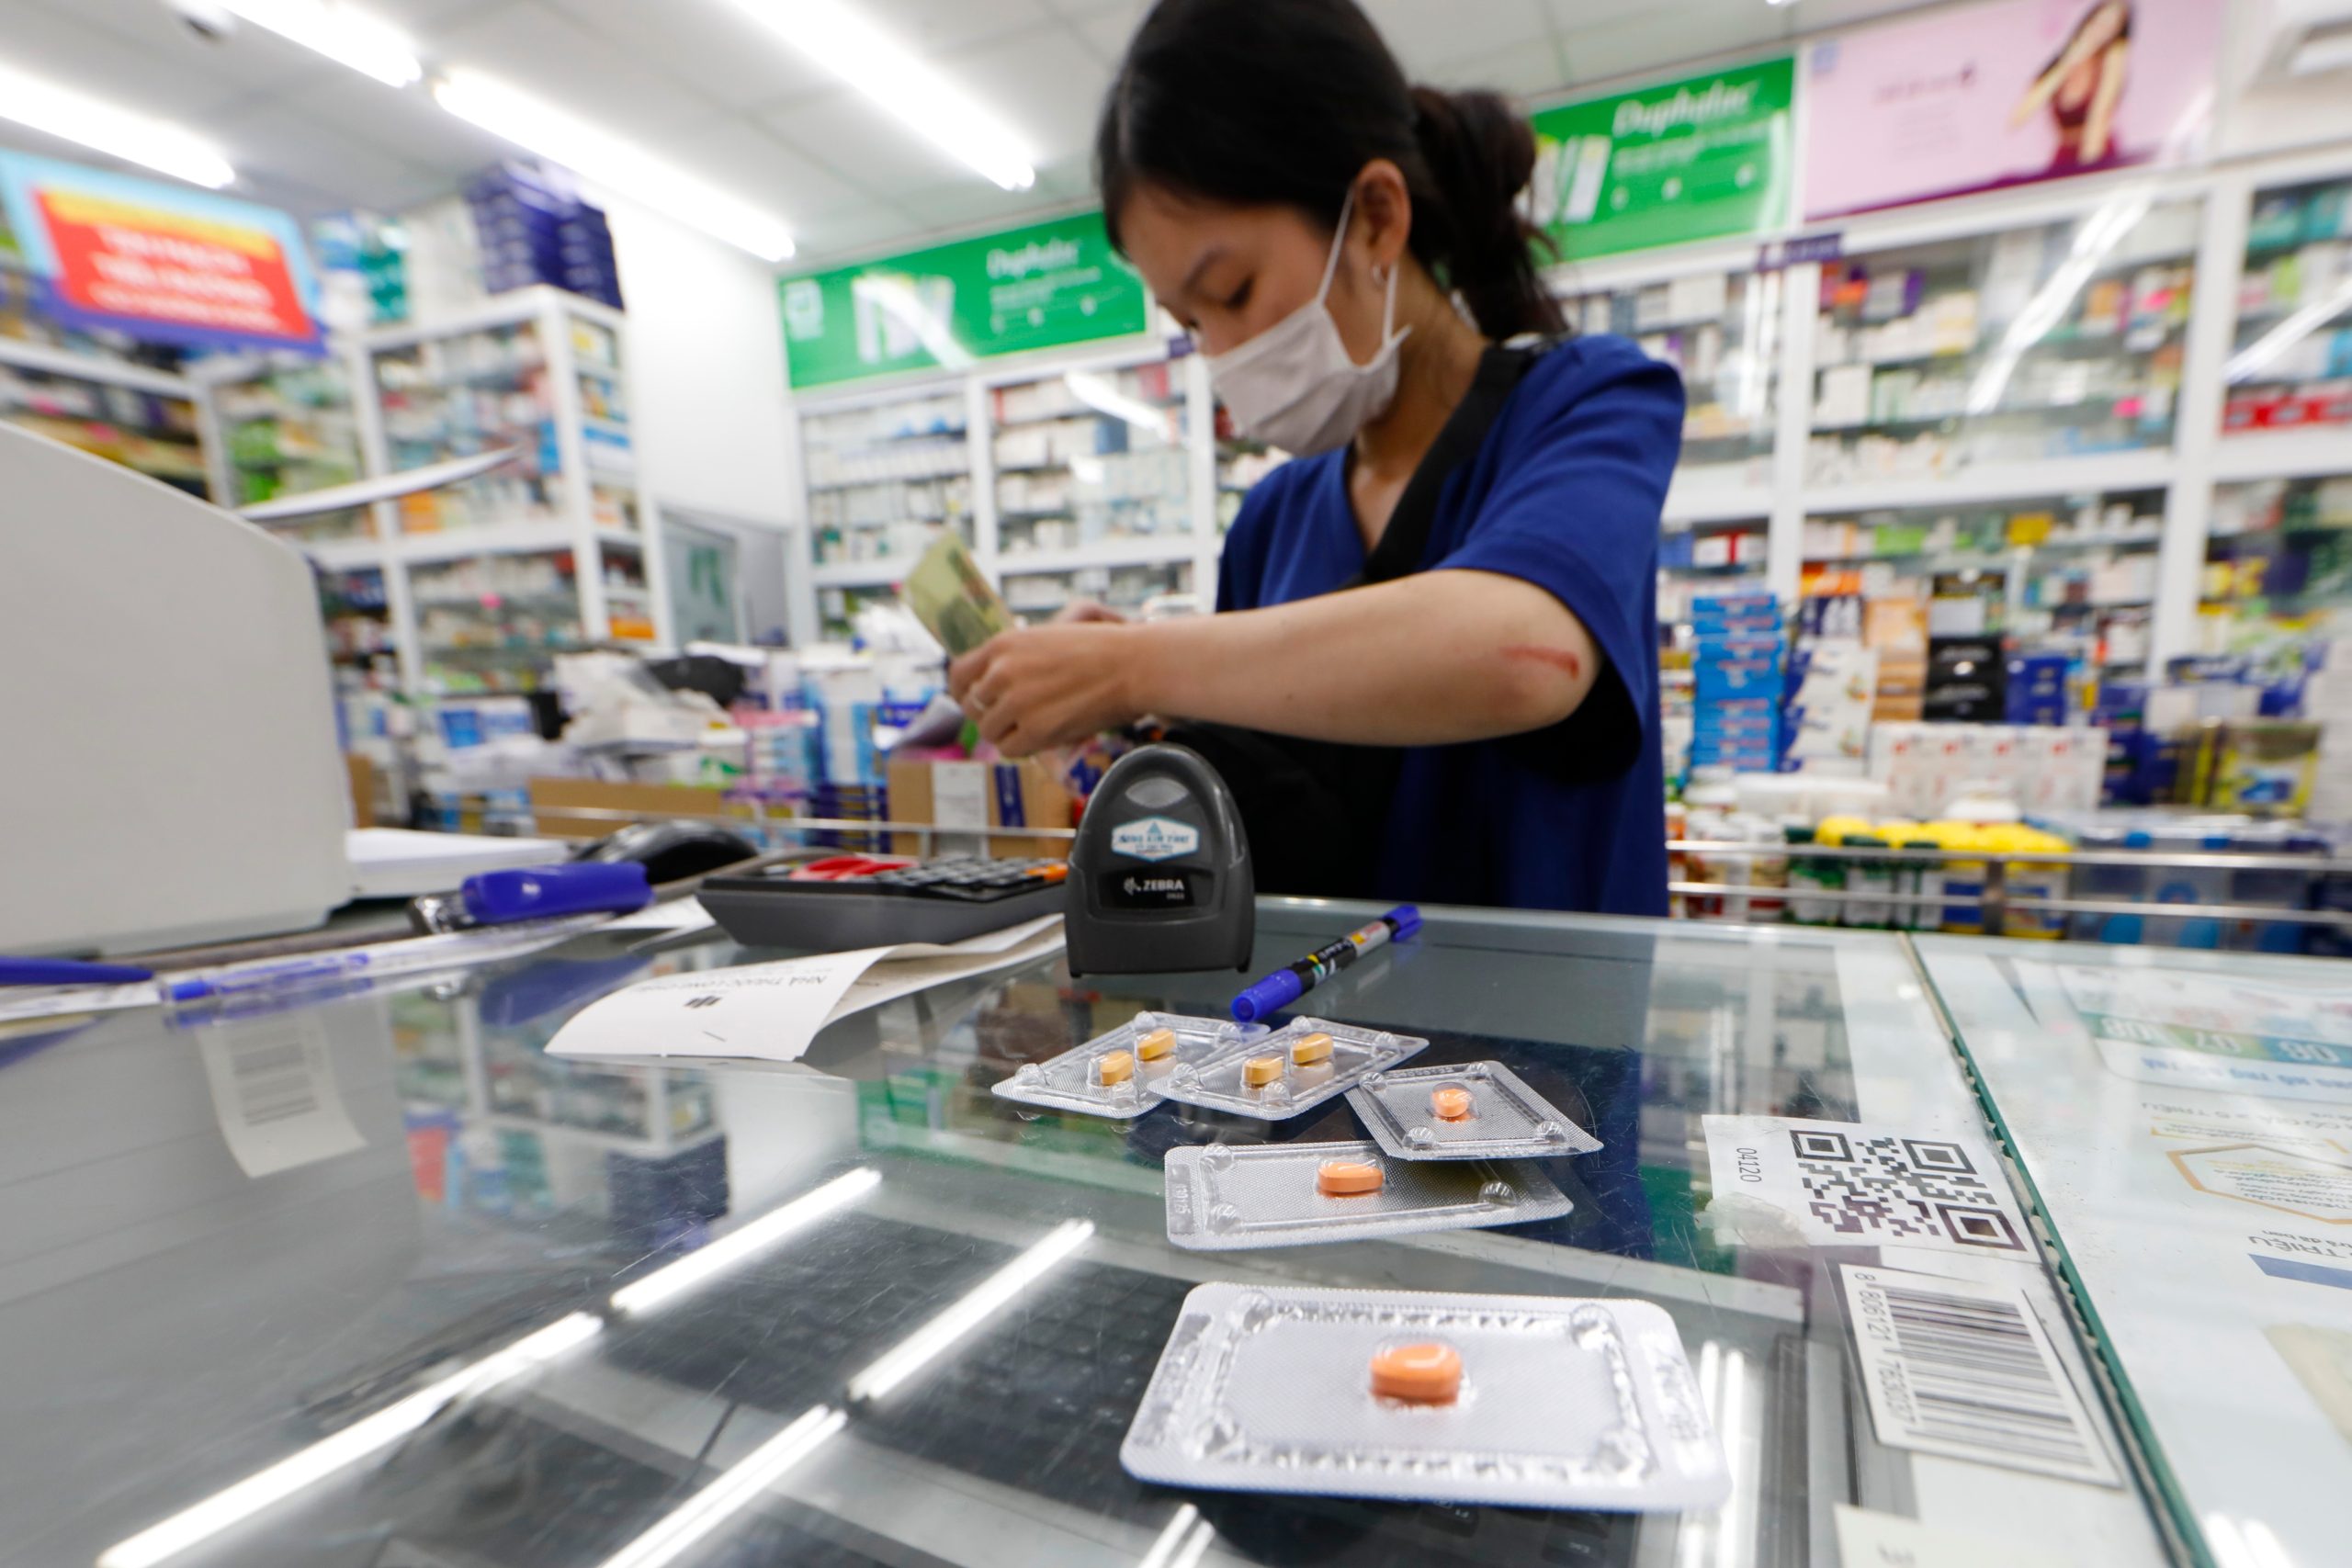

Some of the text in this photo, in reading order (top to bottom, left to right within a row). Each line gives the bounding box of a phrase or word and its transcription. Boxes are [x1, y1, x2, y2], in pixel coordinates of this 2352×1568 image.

[1143, 879, 1184, 891] ZEBRA
[1736, 1148, 1761, 1182] 04120
[2248, 1235, 2347, 1258] TRIỆU
[1855, 1272, 1876, 1281] 8
[1860, 1289, 1894, 1342] 806121
